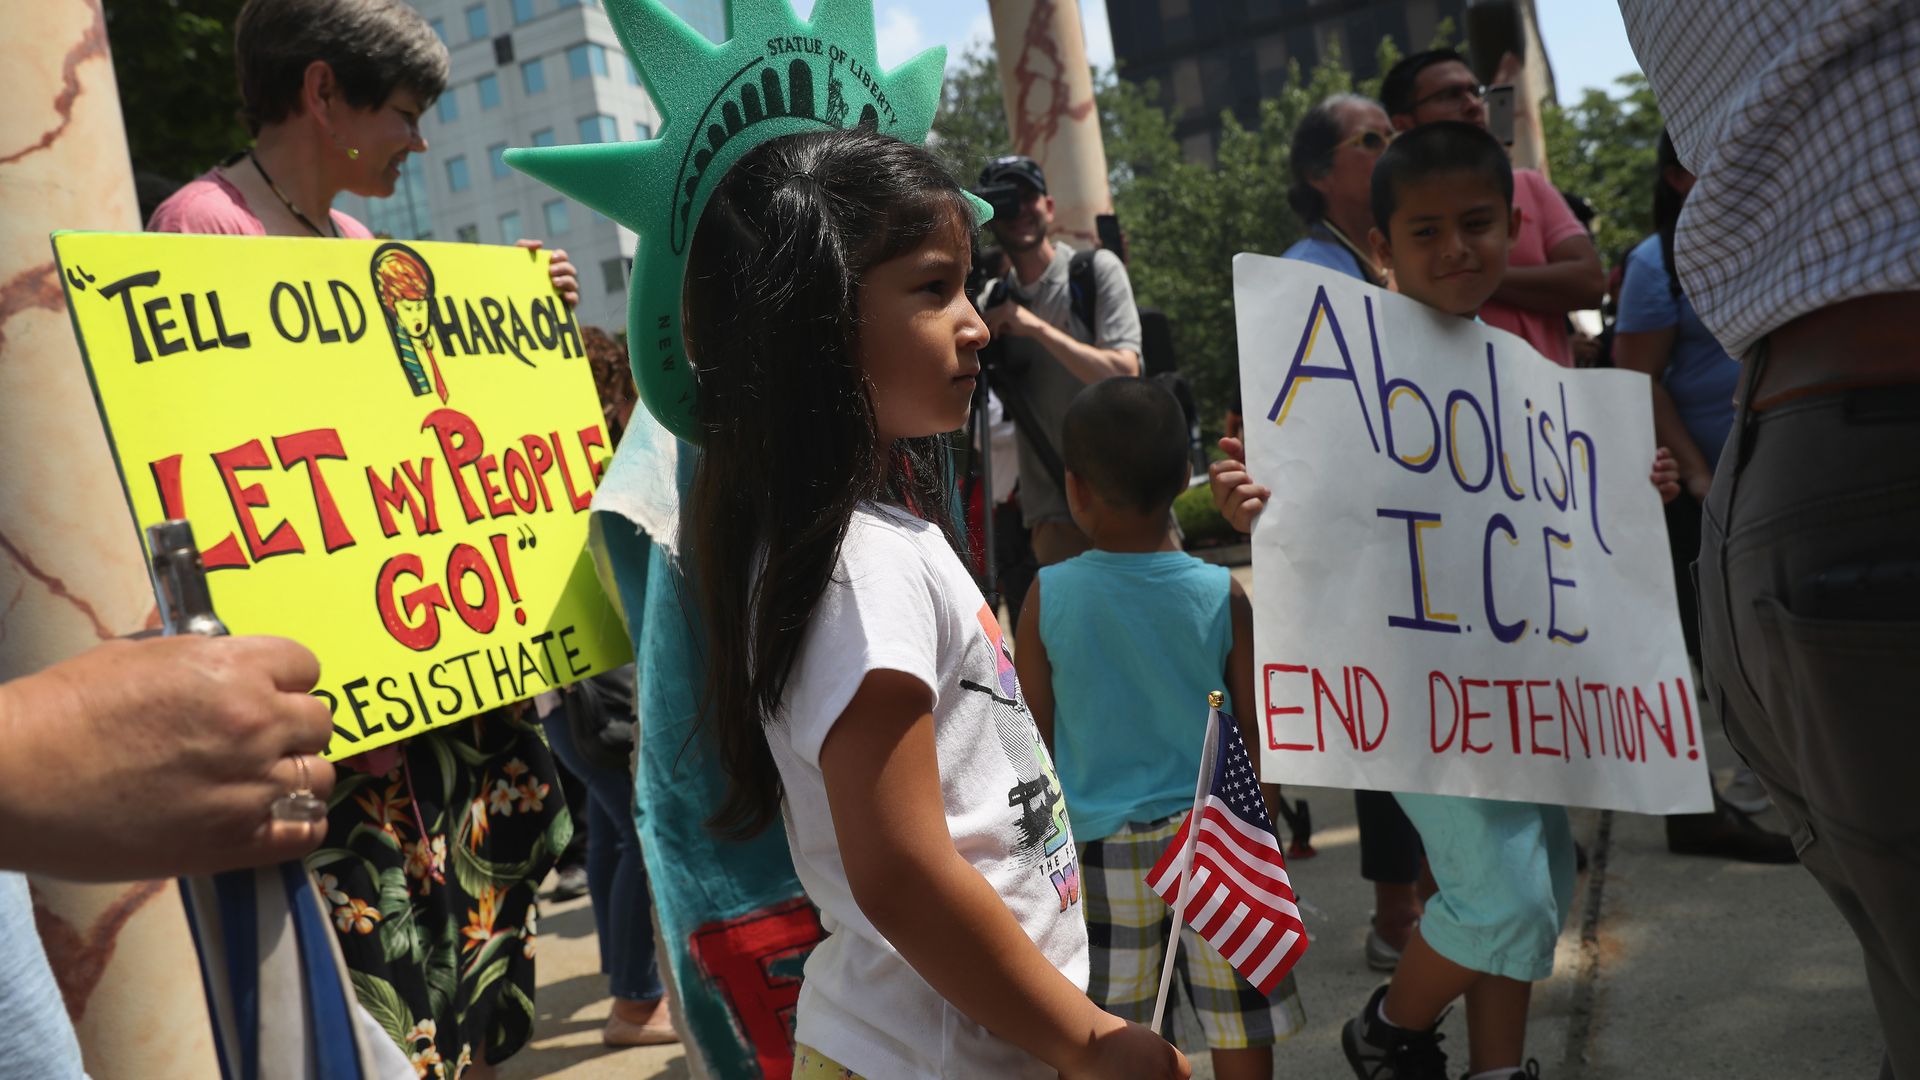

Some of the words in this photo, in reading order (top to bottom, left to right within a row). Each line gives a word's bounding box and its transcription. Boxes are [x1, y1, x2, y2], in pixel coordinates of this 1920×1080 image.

[767, 36, 823, 56] STATUE
[828, 44, 848, 64] OF
[849, 58, 898, 124] LIBERTY
[269, 279, 367, 344] OLD
[658, 315, 676, 372] NEW
[1267, 285, 1612, 555] Abolish
[149, 428, 357, 572] LET
[365, 457, 442, 538] MY
[420, 408, 605, 523] PEOPLE
[1263, 663, 1389, 752] END
[1428, 670, 1699, 763] DETENTION!
[1039, 854, 1060, 876] THE
